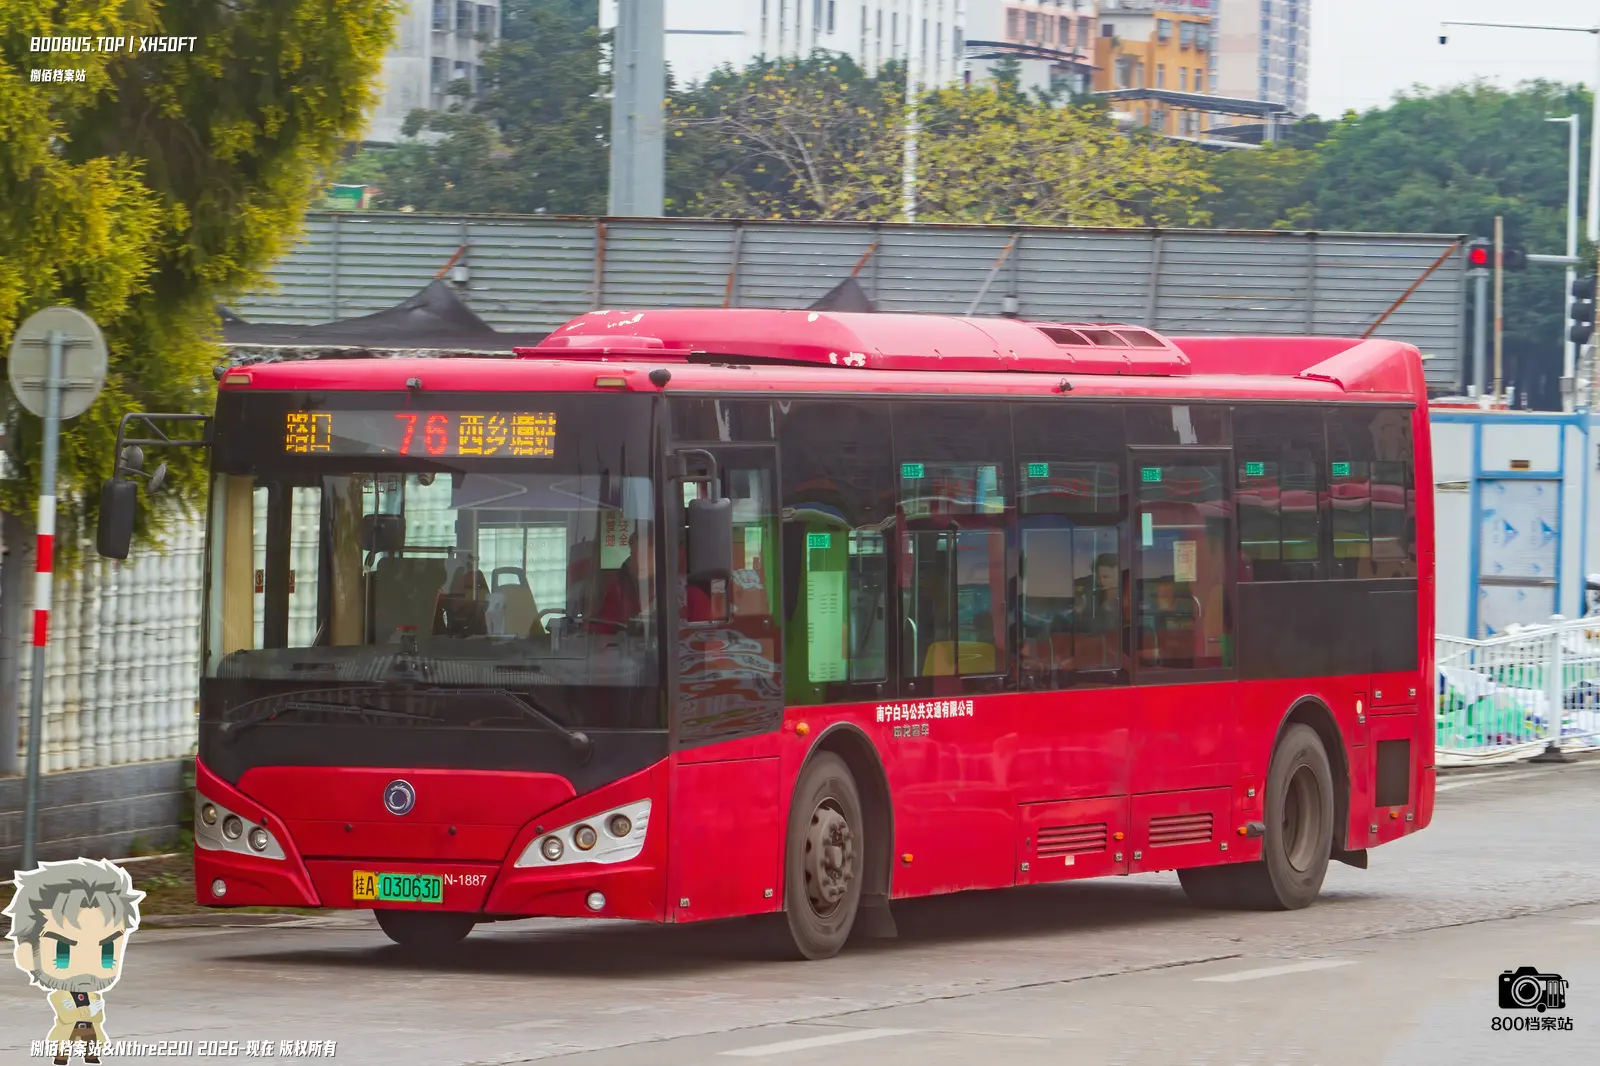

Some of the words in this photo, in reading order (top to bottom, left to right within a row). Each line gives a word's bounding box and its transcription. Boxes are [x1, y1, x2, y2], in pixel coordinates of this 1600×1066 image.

[395, 413, 449, 454] 76
[876, 700, 974, 722] 南宁白马公共交通有限公司
[355, 875, 375, 896] 桂A
[383, 876, 441, 899] 03063D
[444, 873, 487, 887] N-1887
